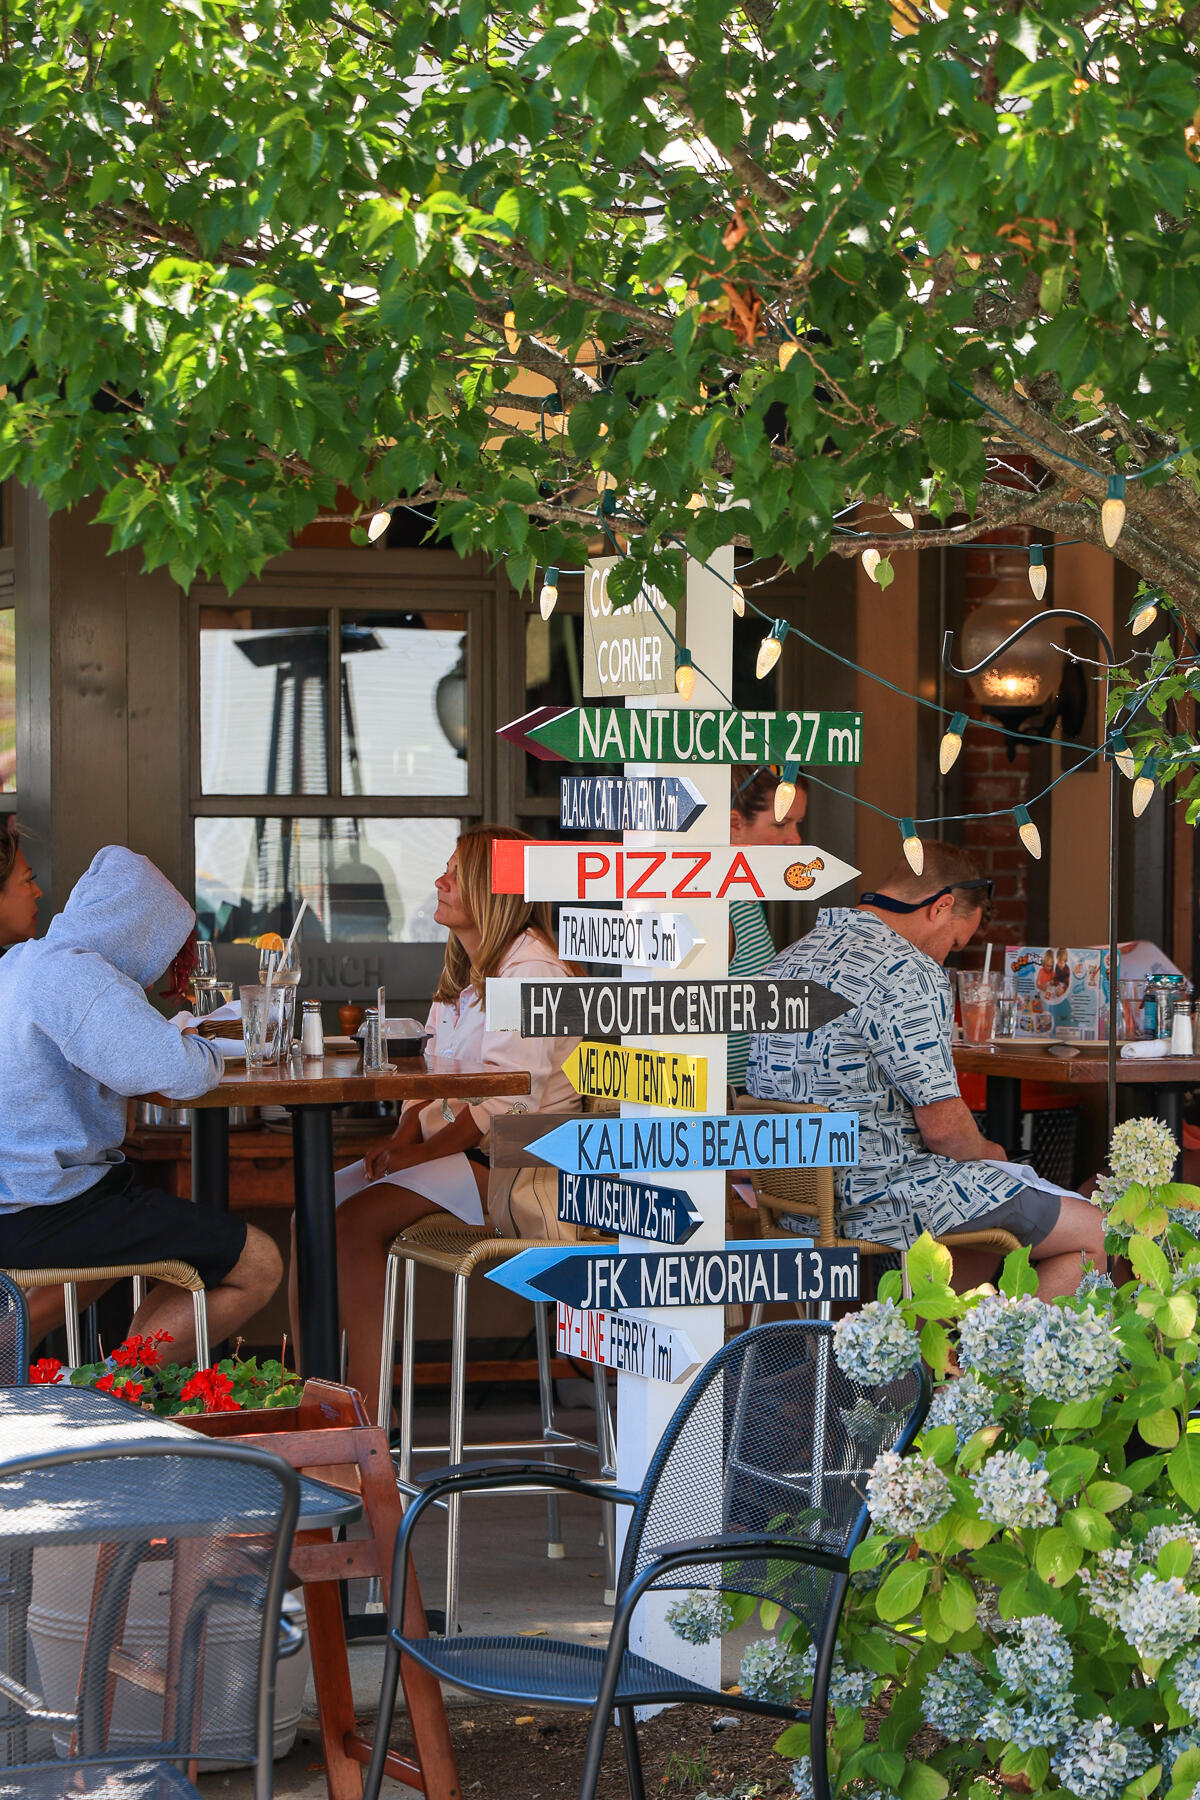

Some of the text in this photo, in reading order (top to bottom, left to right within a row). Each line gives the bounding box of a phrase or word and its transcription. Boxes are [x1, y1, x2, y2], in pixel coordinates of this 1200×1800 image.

[598, 635, 662, 684] CORNER
[578, 707, 862, 763] NANTUCKET 27 mi
[562, 778, 679, 831] BLACK CAT TAVERN .8 mi
[577, 851, 766, 899] PIZZA
[562, 915, 676, 962] TRAIN DEPOT .5 mi
[530, 983, 810, 1035] HY. YOUTH CENTER .3 mi
[578, 1047, 696, 1109] MELODY TENT .5 mi
[577, 1117, 855, 1171] KALMUS BEACH 1.7 mi
[559, 1173, 676, 1243] JFK MUSEUM .25 mi
[580, 1251, 858, 1309] JFK MEMORIAL 1.3 mi
[557, 1301, 673, 1383] HY-LINE FERRY 1 mi
